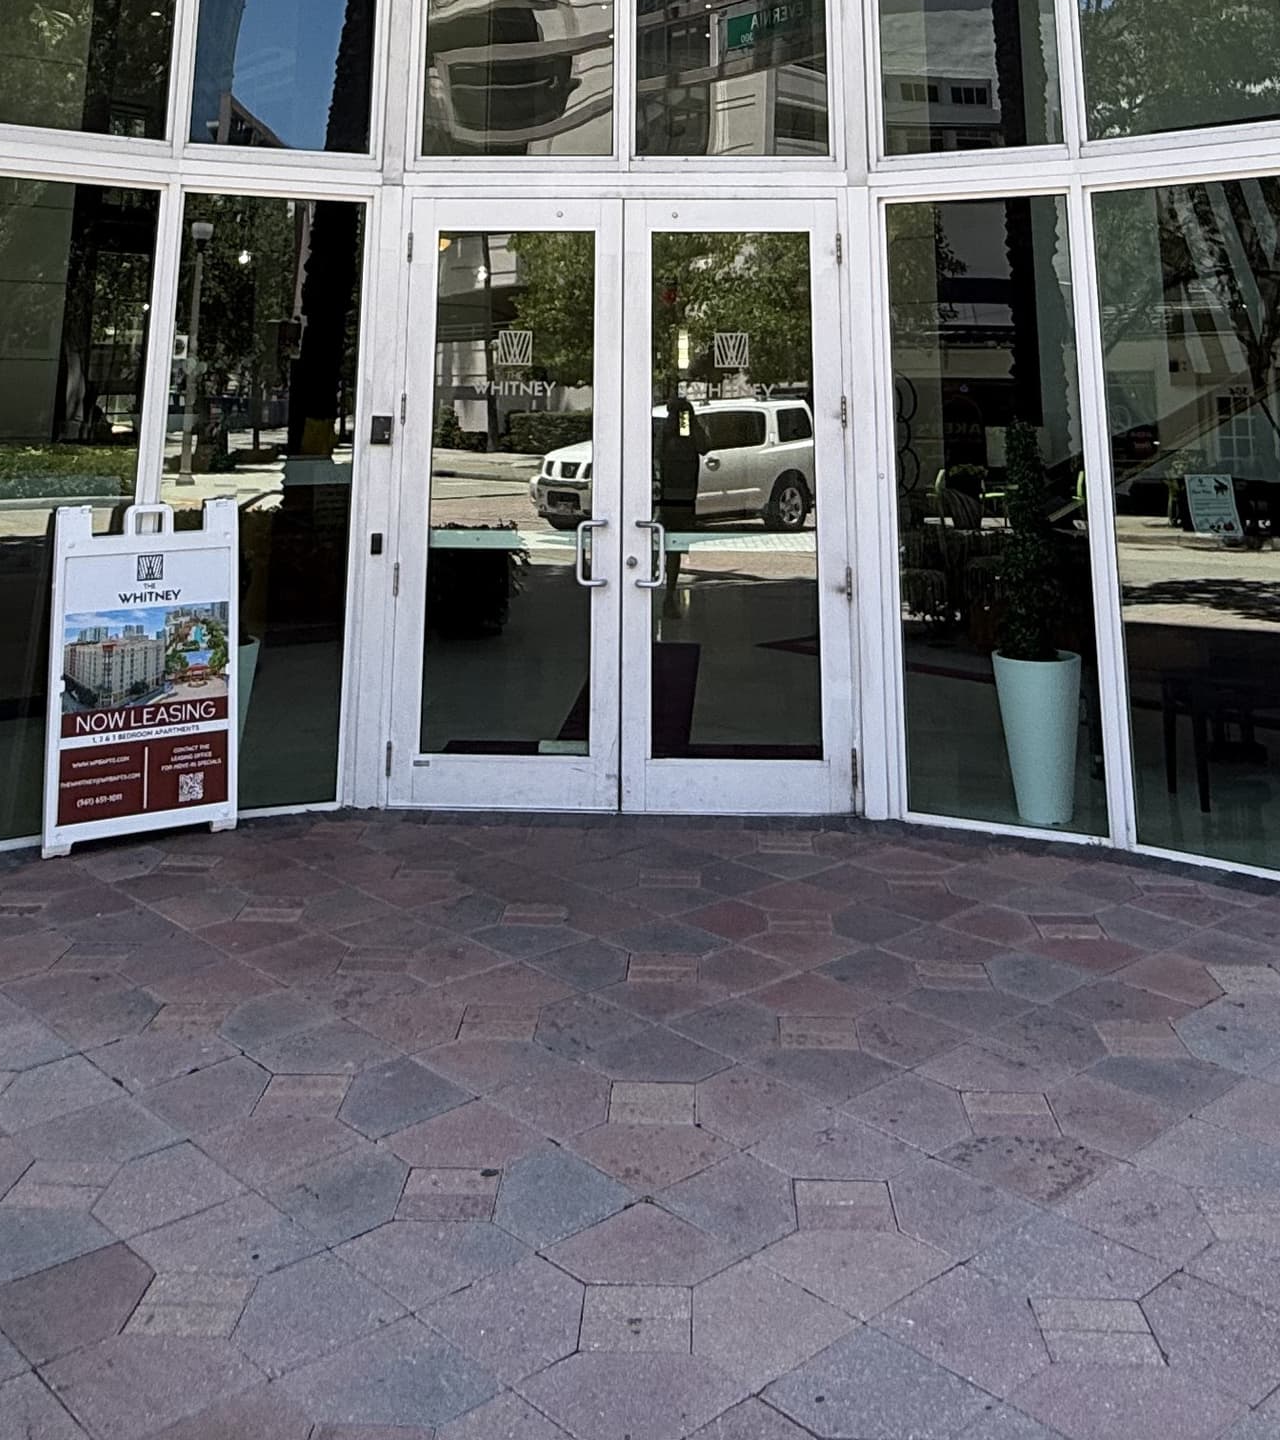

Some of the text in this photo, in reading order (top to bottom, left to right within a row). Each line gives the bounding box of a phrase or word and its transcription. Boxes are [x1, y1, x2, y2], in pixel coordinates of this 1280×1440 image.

[474, 381, 556, 396] WHITNEY
[143, 582, 156, 590] THE
[118, 588, 182, 604] WHITNEY
[75, 700, 216, 734] NOW LEASING
[118, 731, 153, 740] BEDROOM
[154, 724, 200, 736] APARTMENTS
